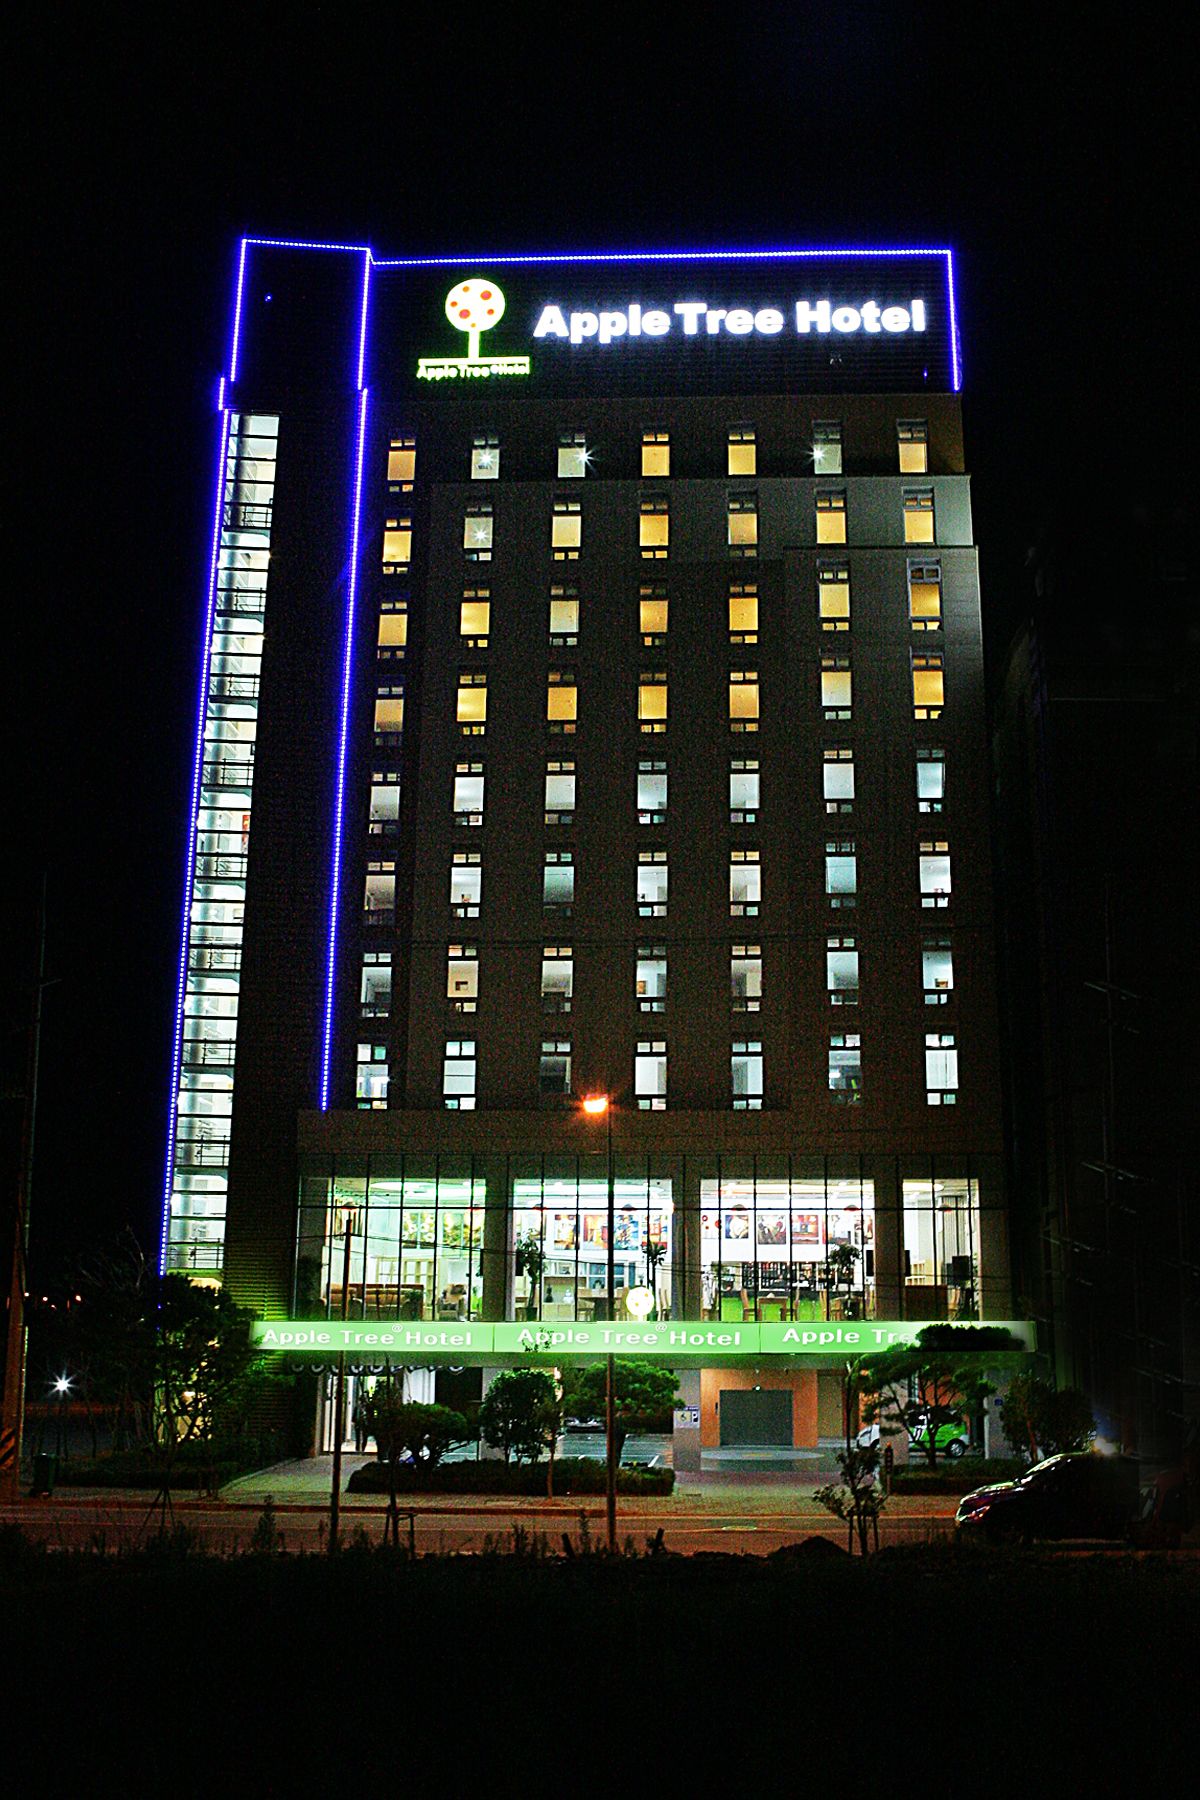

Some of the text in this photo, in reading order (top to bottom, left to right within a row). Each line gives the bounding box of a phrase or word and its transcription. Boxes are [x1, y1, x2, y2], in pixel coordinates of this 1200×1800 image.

[532, 299, 927, 344] Apple Tree Hotel
[416, 364, 458, 381] Apple
[262, 1329, 331, 1345] Apple
[339, 1330, 395, 1345] Tree
[405, 1331, 473, 1346] Hotel
[517, 1328, 590, 1346] Apple
[600, 1329, 659, 1345] Tree
[669, 1331, 742, 1346] Hotel
[782, 1328, 861, 1345] Apple
